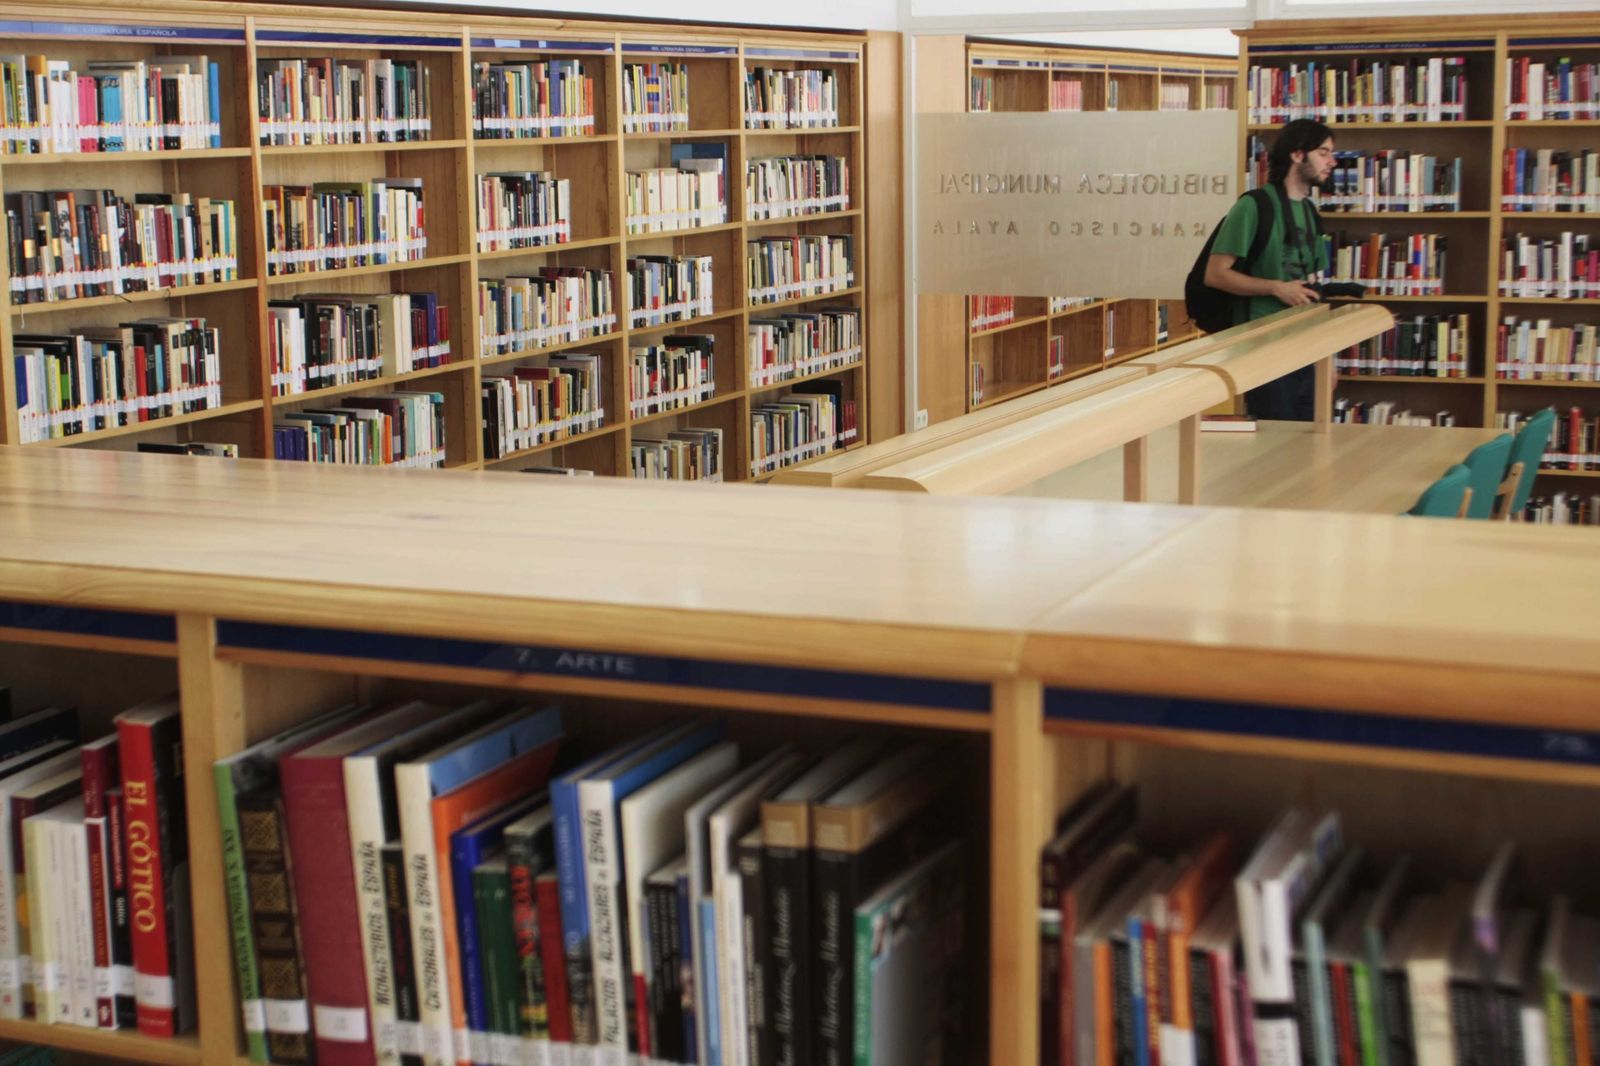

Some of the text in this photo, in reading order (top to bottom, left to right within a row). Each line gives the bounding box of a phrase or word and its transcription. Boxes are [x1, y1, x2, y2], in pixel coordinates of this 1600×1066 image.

[555, 652, 634, 674] ARTE
[125, 780, 158, 933] EL GÓTICO
